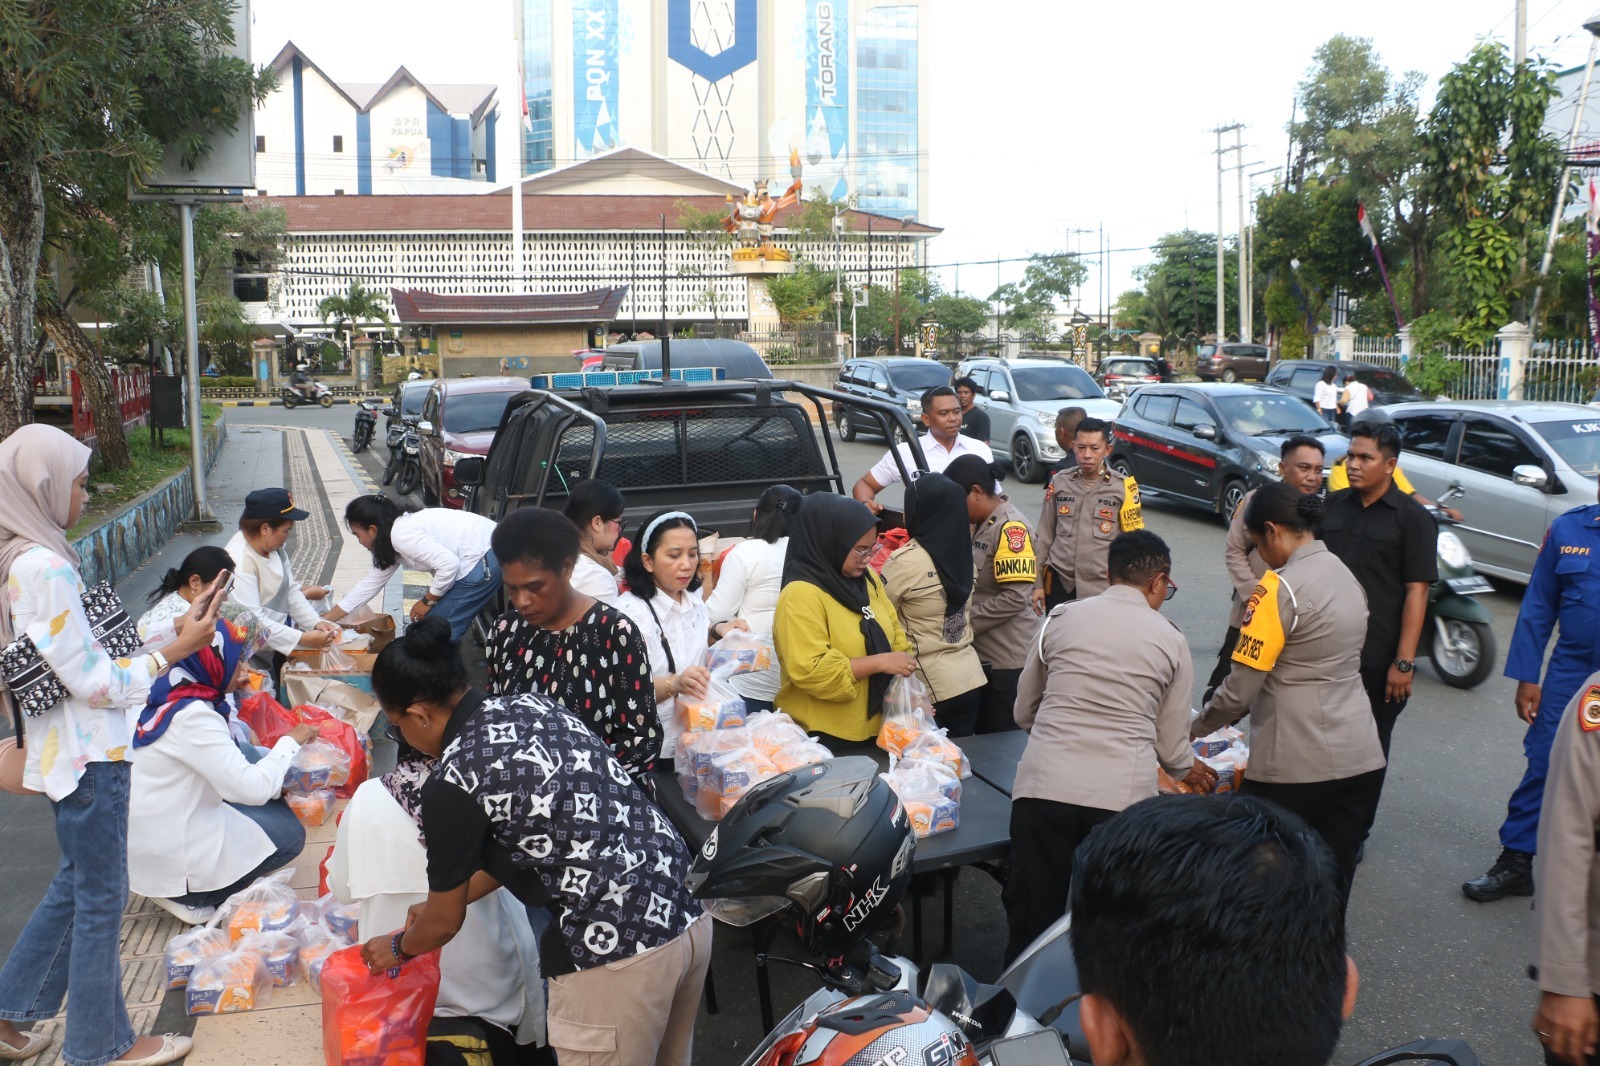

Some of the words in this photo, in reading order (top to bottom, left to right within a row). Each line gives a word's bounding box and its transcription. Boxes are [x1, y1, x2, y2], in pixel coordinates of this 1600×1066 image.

[585, 9, 606, 40] XX
[818, 4, 834, 98] TORANG
[585, 49, 606, 101] PON
[394, 117, 421, 127] DPR
[390, 127, 424, 136] PAPUA
[1571, 422, 1600, 434] KJK
[1098, 498, 1120, 508] POLRI
[1560, 545, 1590, 556] YOPPI
[842, 873, 891, 932] NHK
[951, 1010, 983, 1030] HONDA
